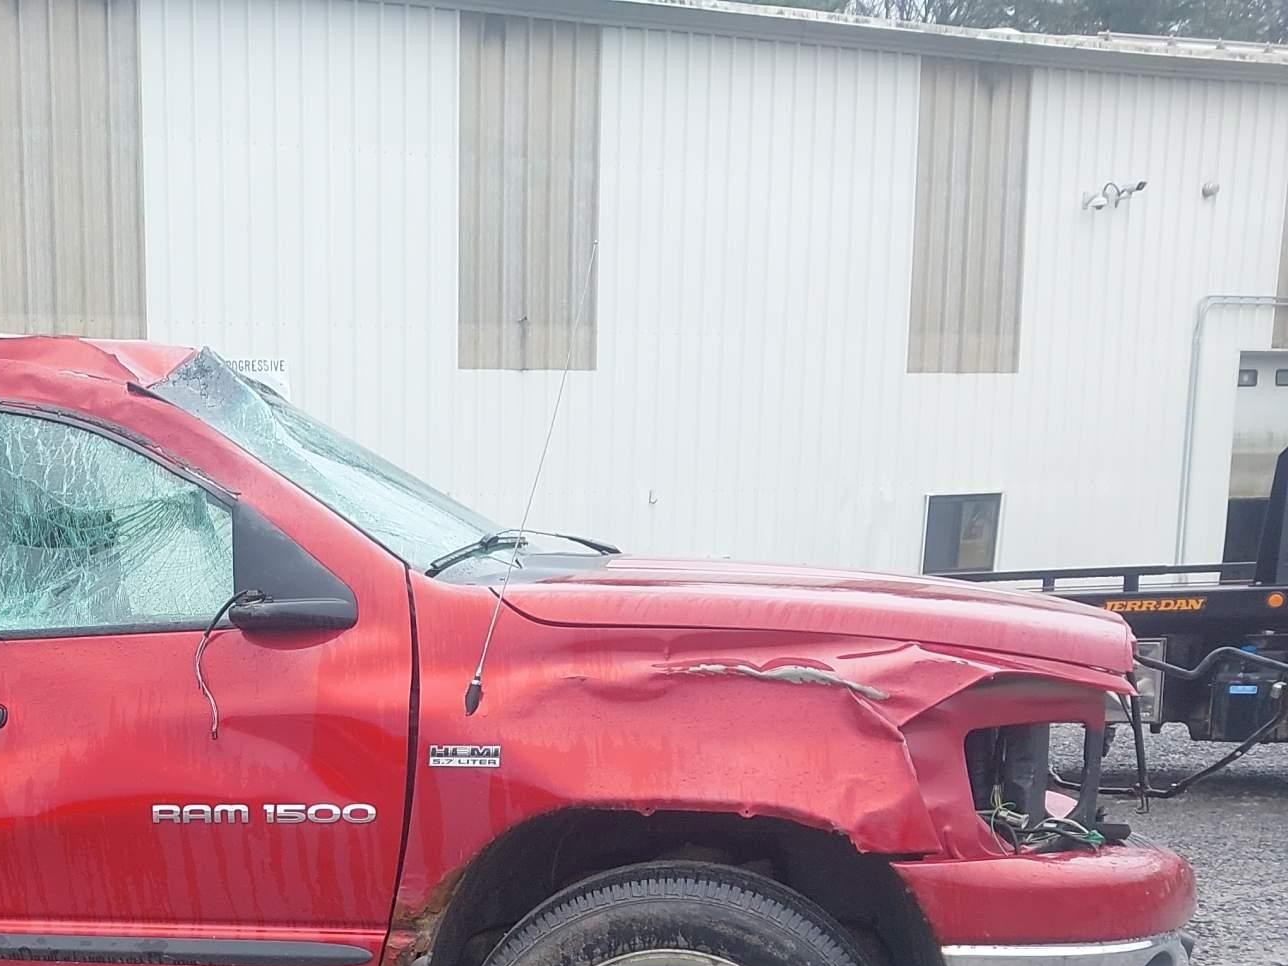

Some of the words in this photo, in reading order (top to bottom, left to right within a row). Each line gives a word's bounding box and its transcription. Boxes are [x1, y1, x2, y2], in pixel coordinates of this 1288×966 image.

[429, 745, 501, 757] HEMI
[151, 804, 249, 823] RAM
[263, 803, 377, 823] 1500
